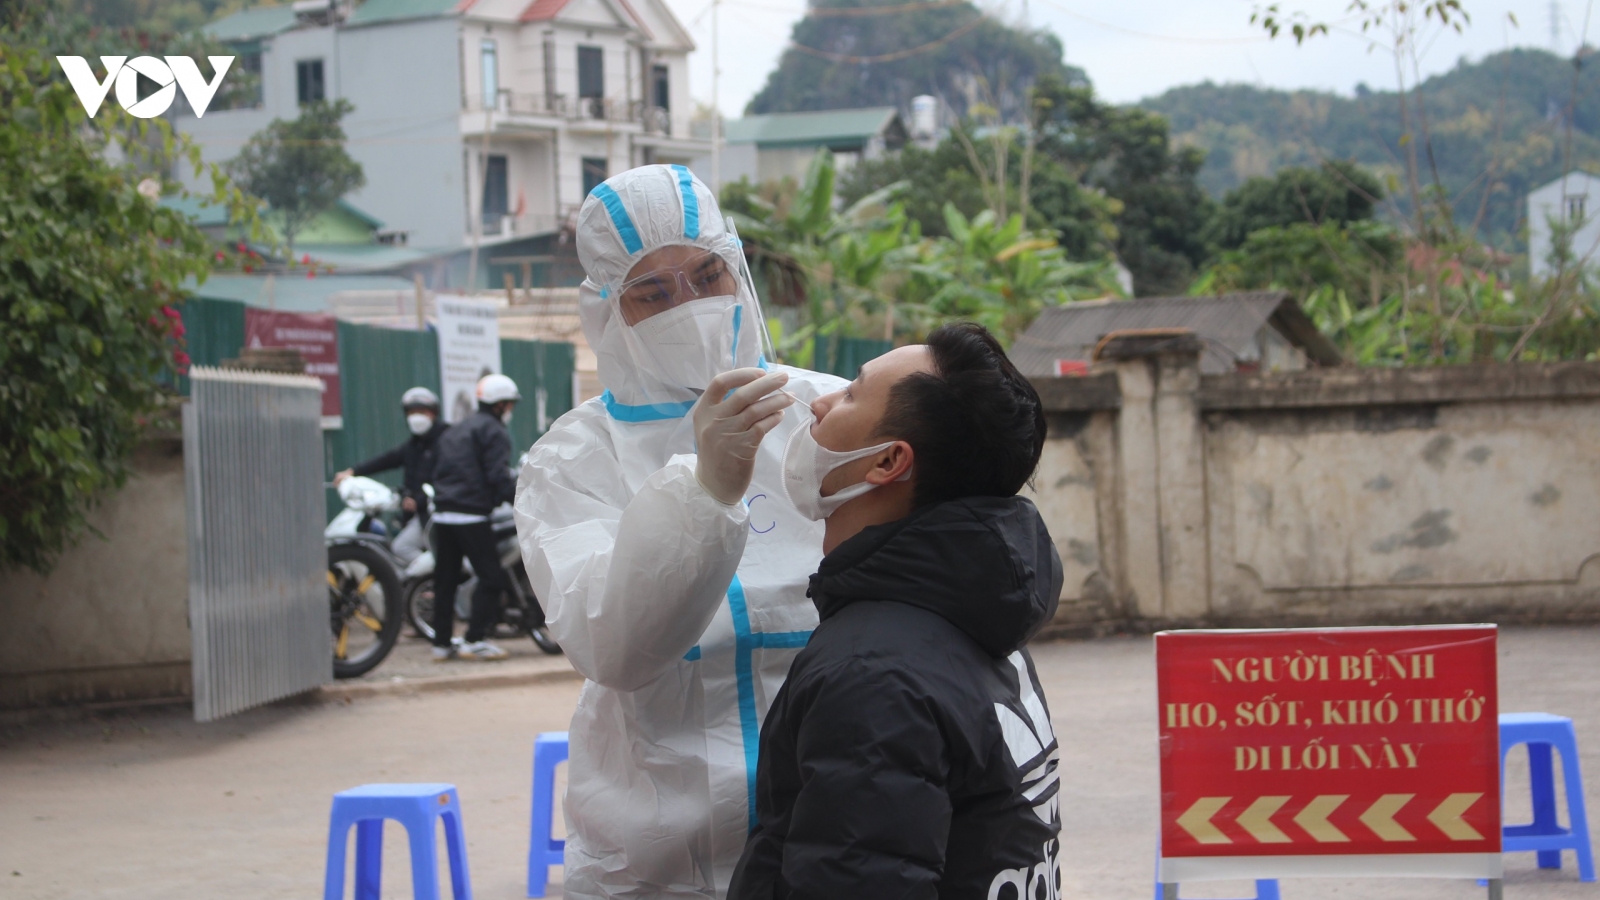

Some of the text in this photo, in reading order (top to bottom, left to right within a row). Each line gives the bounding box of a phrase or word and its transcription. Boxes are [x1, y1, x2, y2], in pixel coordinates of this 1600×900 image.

[1211, 648, 1436, 687] NGƯỜI BỆNH
[1165, 689, 1486, 731] HO, SỐT, KHÓ THỞ
[1280, 737, 1340, 771] LỐI
[1349, 737, 1425, 769] NÀY
